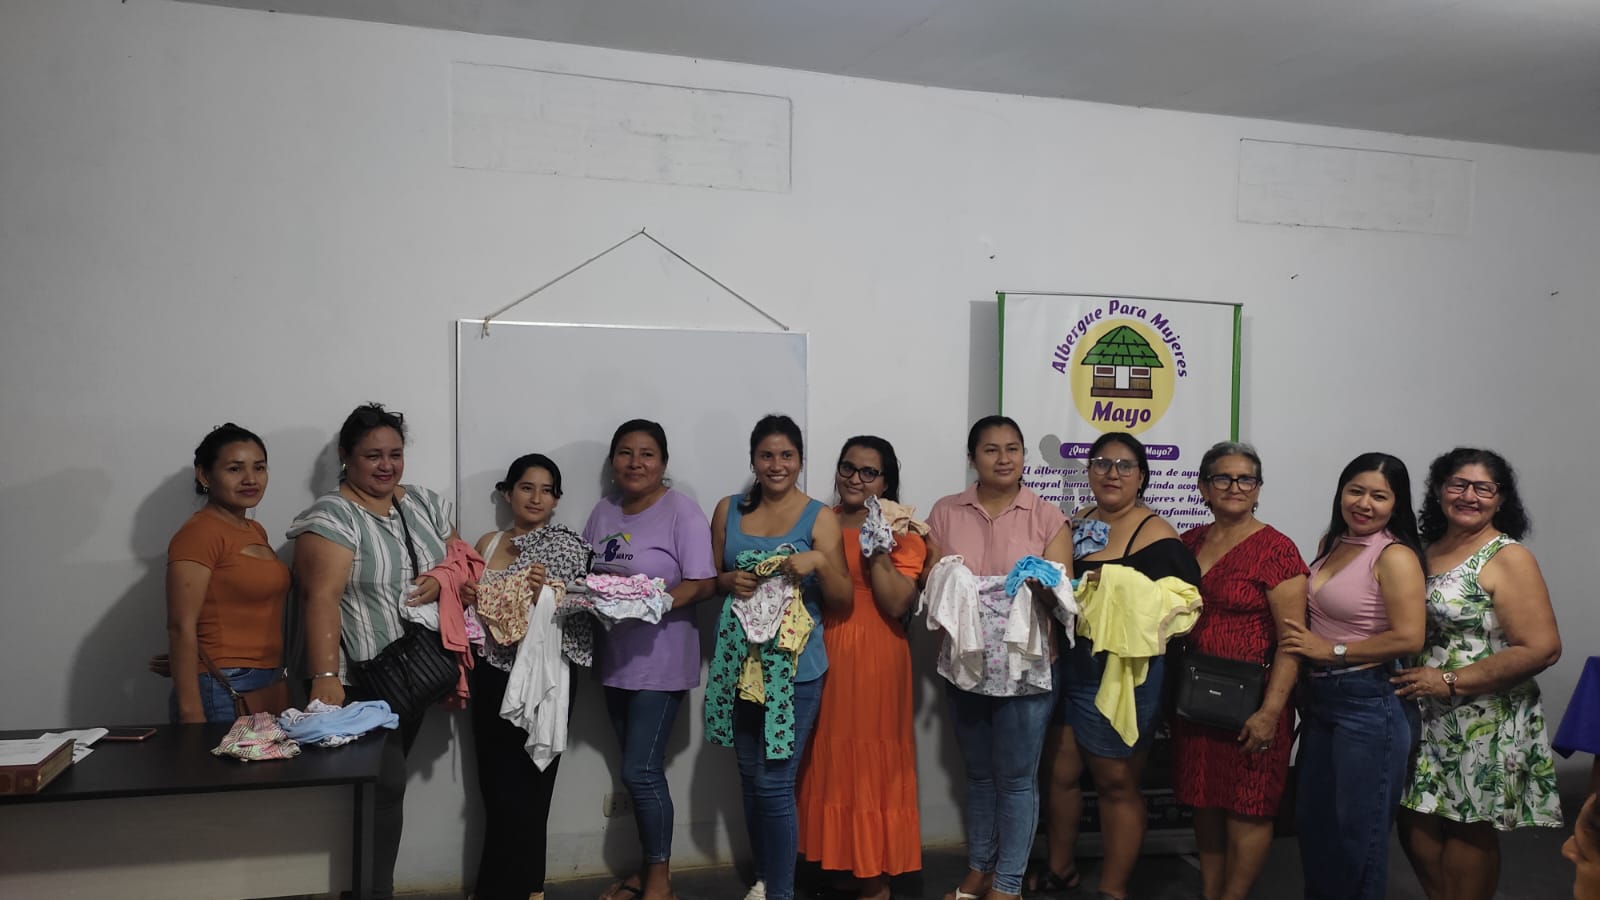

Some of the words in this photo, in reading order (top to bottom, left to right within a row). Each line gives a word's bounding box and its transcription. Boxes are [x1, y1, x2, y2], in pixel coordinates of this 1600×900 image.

[1052, 308, 1102, 374] Albergue
[1109, 300, 1147, 319] Para
[1150, 313, 1187, 377] Mujeres
[1091, 401, 1152, 428] Mayo
[1145, 446, 1173, 457] Mayo?
[1034, 466, 1078, 477] albergue
[1166, 468, 1178, 477] de
[1181, 470, 1200, 479] ayu
[1064, 480, 1089, 488] huma
